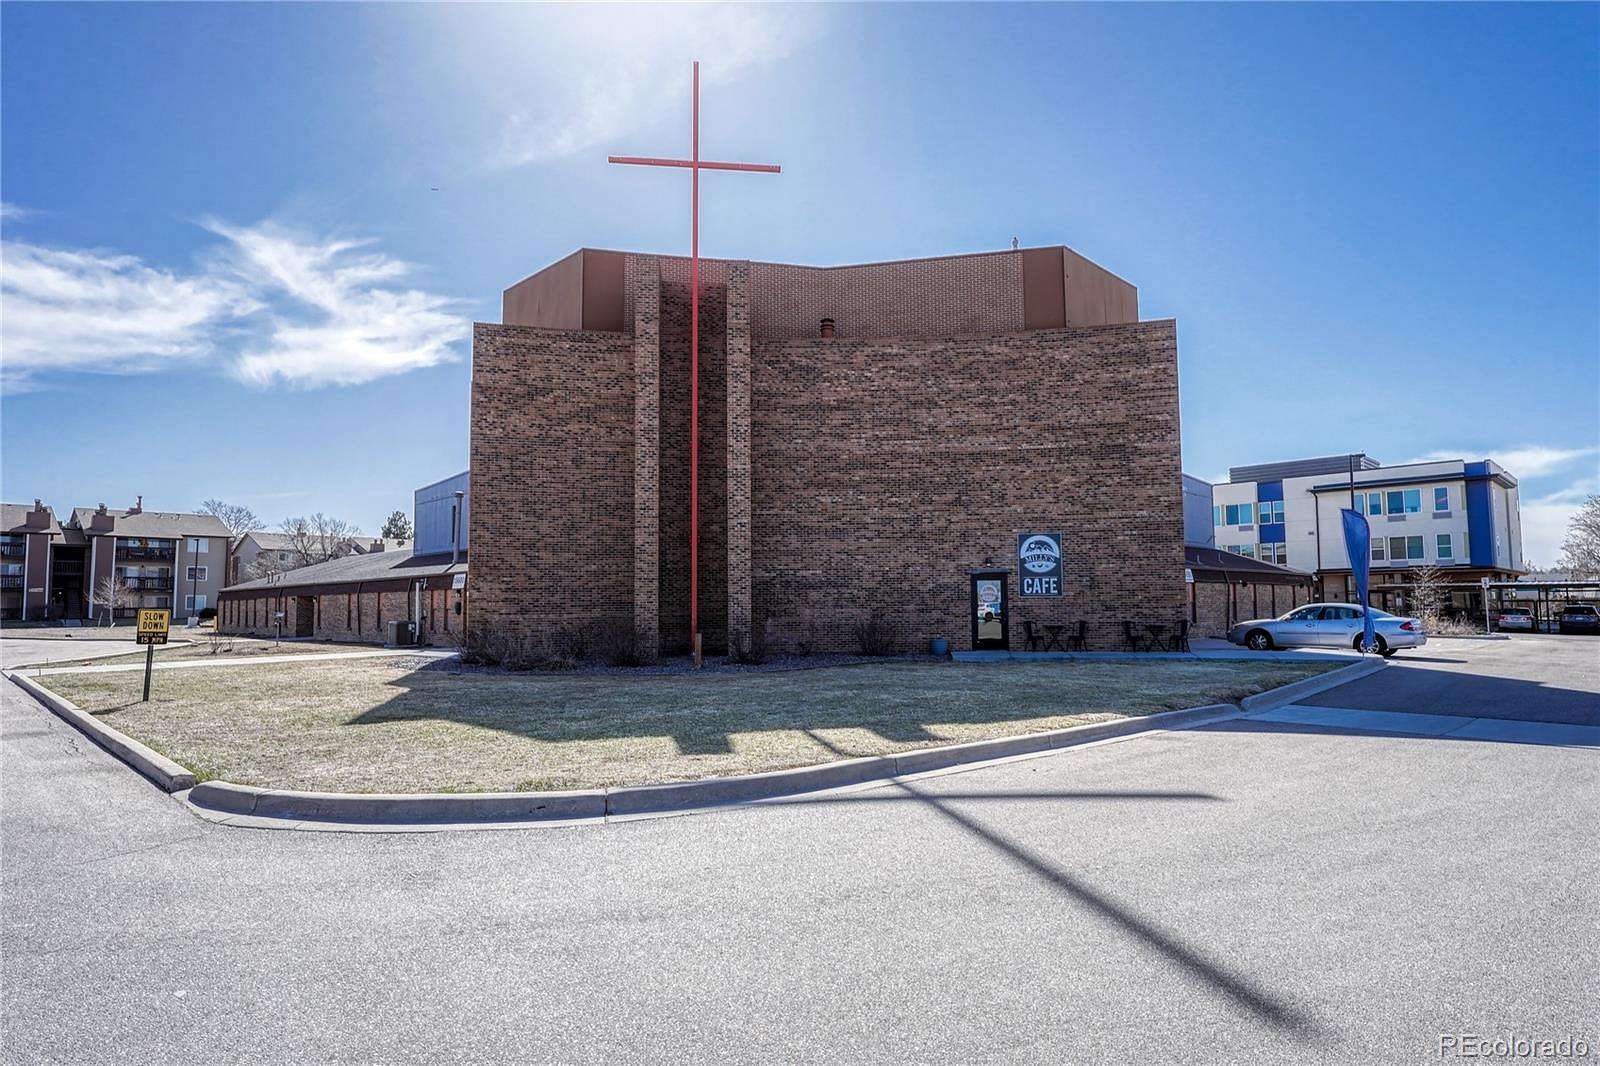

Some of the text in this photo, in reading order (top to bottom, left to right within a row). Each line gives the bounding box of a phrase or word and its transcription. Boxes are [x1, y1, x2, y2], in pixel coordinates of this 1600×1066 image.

[1024, 578, 1058, 594] CAFE
[144, 612, 164, 621] SLOW
[143, 621, 164, 630] DOWN
